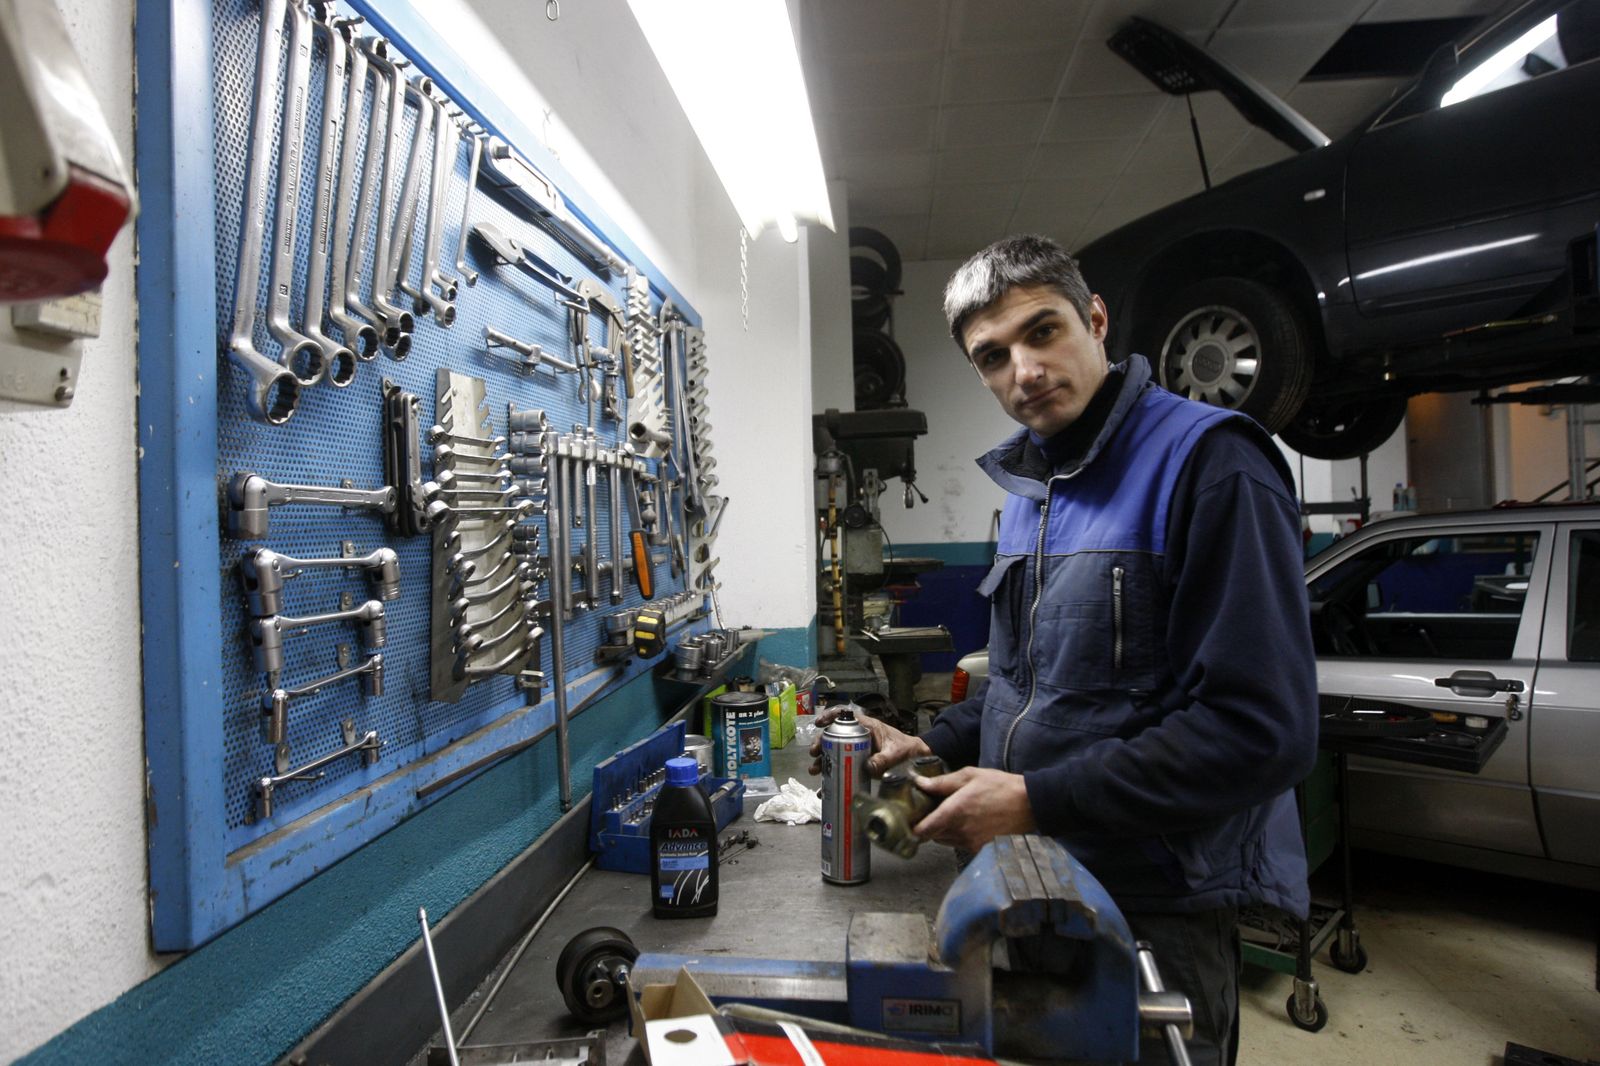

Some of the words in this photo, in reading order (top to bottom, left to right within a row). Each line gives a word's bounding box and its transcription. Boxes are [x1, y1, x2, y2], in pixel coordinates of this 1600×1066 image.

[726, 711, 737, 779] MOLYKOTE
[668, 826, 699, 838] IADA
[660, 842, 708, 851] Advance
[908, 1004, 953, 1016] IRIMO
